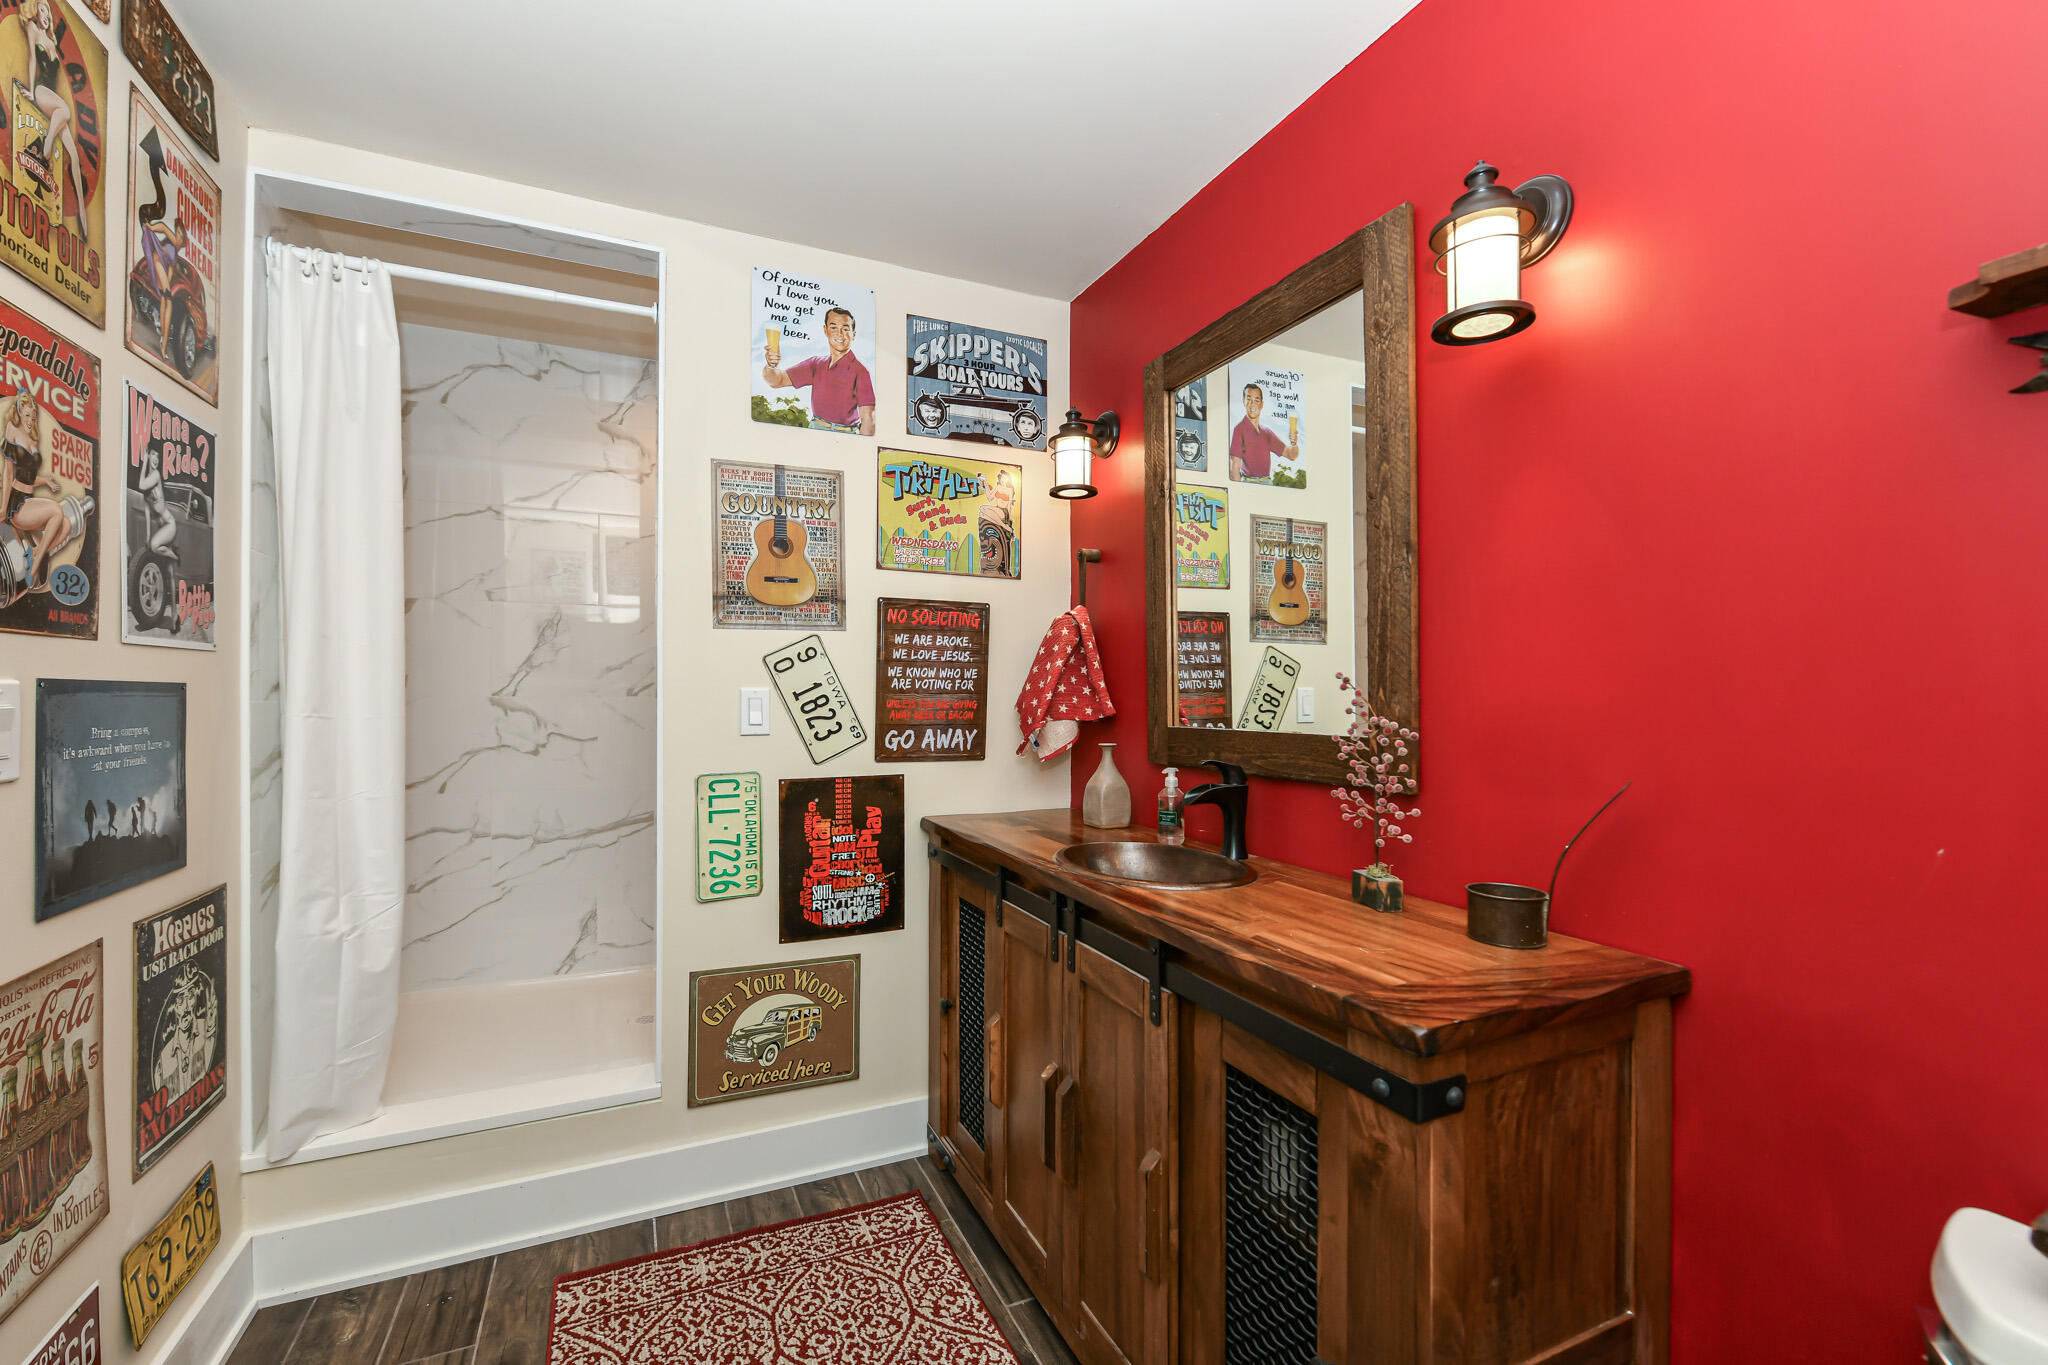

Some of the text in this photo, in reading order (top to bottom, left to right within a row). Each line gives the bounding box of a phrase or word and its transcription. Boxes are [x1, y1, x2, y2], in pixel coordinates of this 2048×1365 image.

[166, 147, 214, 218] DANGEROUS
[177, 187, 213, 256] CURVES
[0, 177, 100, 290] TOR OILS
[0, 225, 92, 304] horized Dealer
[185, 238, 213, 282] AHEAD
[762, 270, 820, 290] Of course
[776, 285, 839, 306] I love you.
[764, 297, 814, 316] Now get
[770, 313, 800, 325] me a
[913, 319, 949, 335] FREE LUNCH
[783, 325, 810, 340] beer.
[1006, 336, 1043, 356] EXOTIC LOCALES
[0, 325, 90, 403] ependable
[913, 333, 1043, 395] SKIPPER'S
[971, 360, 996, 371] HOUR
[937, 363, 1024, 392] BOAT TOURS
[0, 358, 85, 422] RVICE
[130, 386, 190, 468] Wanna
[51, 429, 91, 464] SPARK
[163, 435, 209, 482] Ride?
[51, 453, 91, 487] PLUGS
[912, 460, 942, 478] THE
[938, 468, 979, 501] HUT
[722, 491, 836, 520] COUNTRY
[905, 495, 935, 516] Surf,
[918, 503, 950, 523] Sand,
[929, 514, 967, 532] & Suds
[891, 536, 959, 551] WEDNESDAYS
[894, 547, 923, 557] LADIES
[887, 608, 981, 629] NO SOLICITING
[894, 633, 972, 648] WE ARE BROKE,
[892, 648, 908, 660] WE
[911, 649, 937, 660] LOVE
[887, 666, 978, 679] WE KNOW WHO WE
[824, 671, 846, 710] IOWA
[891, 678, 974, 691] ARE VOTING FOR
[792, 682, 843, 741] 1823
[886, 699, 978, 710] UNLESS YOU ARE GIVING
[890, 710, 974, 720] AWAY BEER OR BACON
[91, 728, 112, 740] Bring
[849, 725, 861, 739] 69
[884, 728, 978, 752] GO AWAY
[63, 748, 75, 760] it's
[78, 744, 112, 758] awkward
[114, 743, 132, 753] when
[808, 801, 817, 812] 6
[745, 778, 758, 889] 75 OKLAHOMA IS OK
[856, 806, 882, 848] Play
[830, 841, 856, 853] JAM
[832, 834, 856, 843] NOTE
[831, 851, 856, 860] FRET
[812, 884, 834, 900] SOUL
[832, 876, 865, 889] MUSIC
[812, 895, 867, 911] RHYTHM
[828, 905, 867, 925] ROCK
[142, 926, 224, 982] USE BACK DOOR
[40, 954, 92, 989] REFRESHING
[701, 968, 848, 1027] GET YOUR WOODY
[719, 1059, 831, 1093] Serviced here
[53, 1212, 63, 1233] IN
[62, 1182, 107, 1230] BOTTLES
